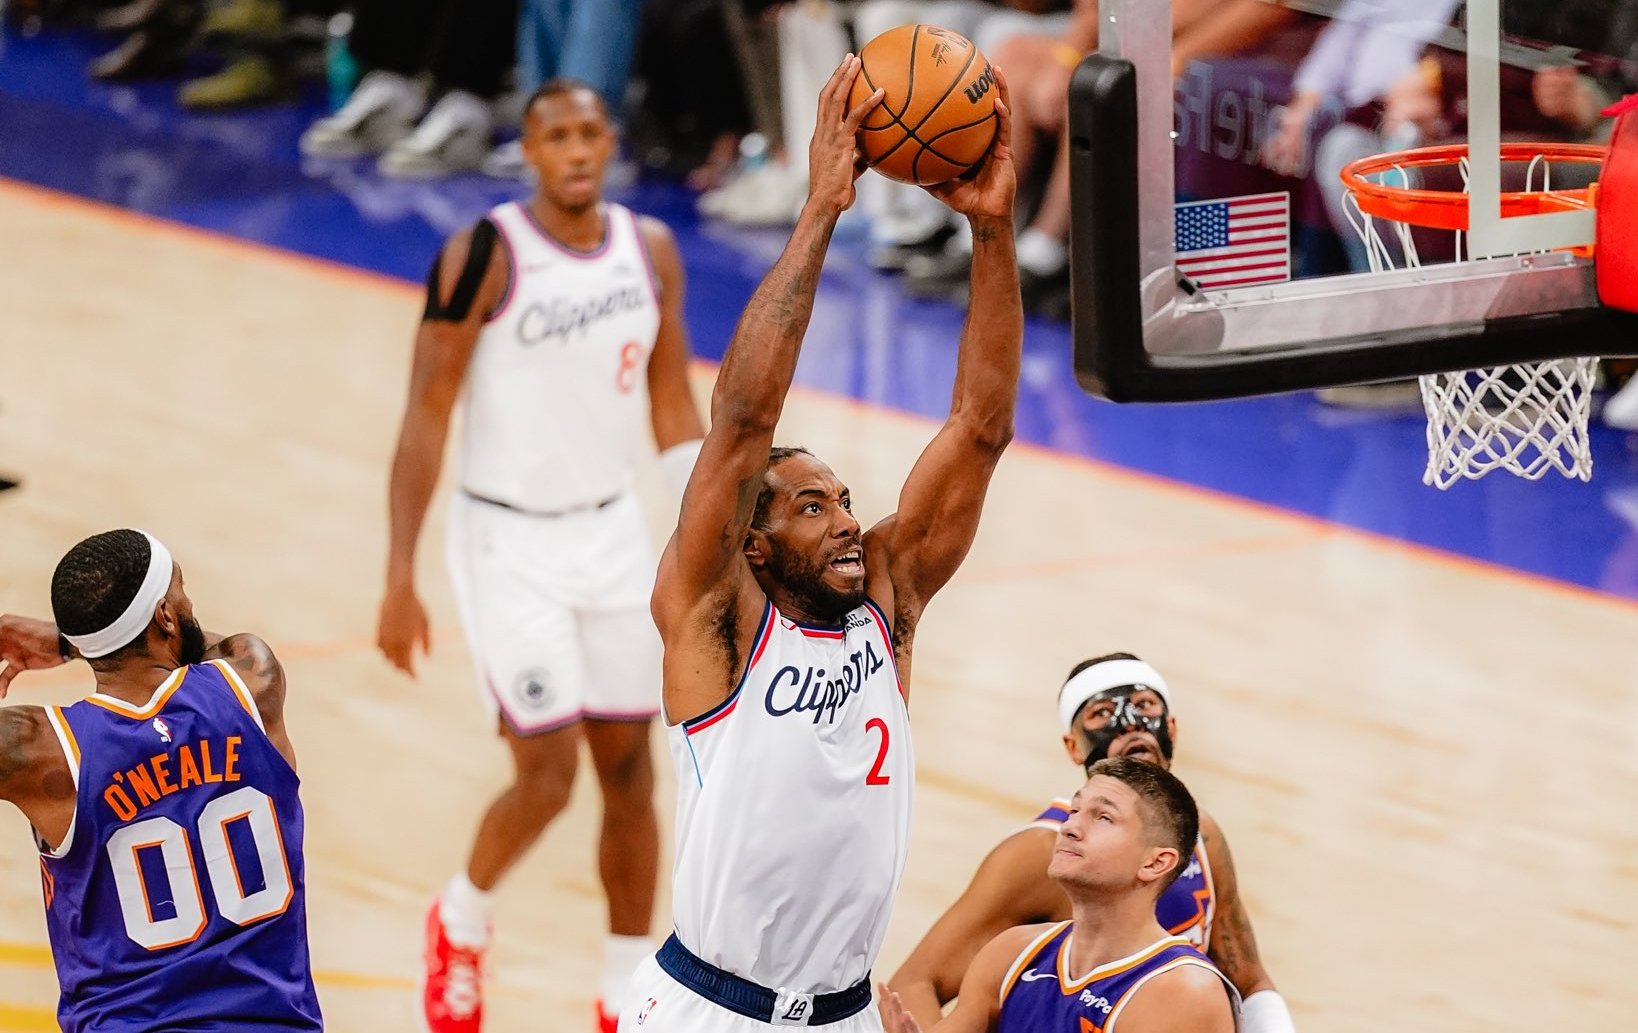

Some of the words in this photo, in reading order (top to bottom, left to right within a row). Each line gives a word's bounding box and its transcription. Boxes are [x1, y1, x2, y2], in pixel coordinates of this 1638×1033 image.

[615, 339, 643, 395] 8
[765, 640, 884, 725] Clippers
[103, 735, 242, 822] O'NEALE
[865, 717, 891, 786] 2
[105, 786, 295, 951] 00
[781, 998, 808, 1021] LA
